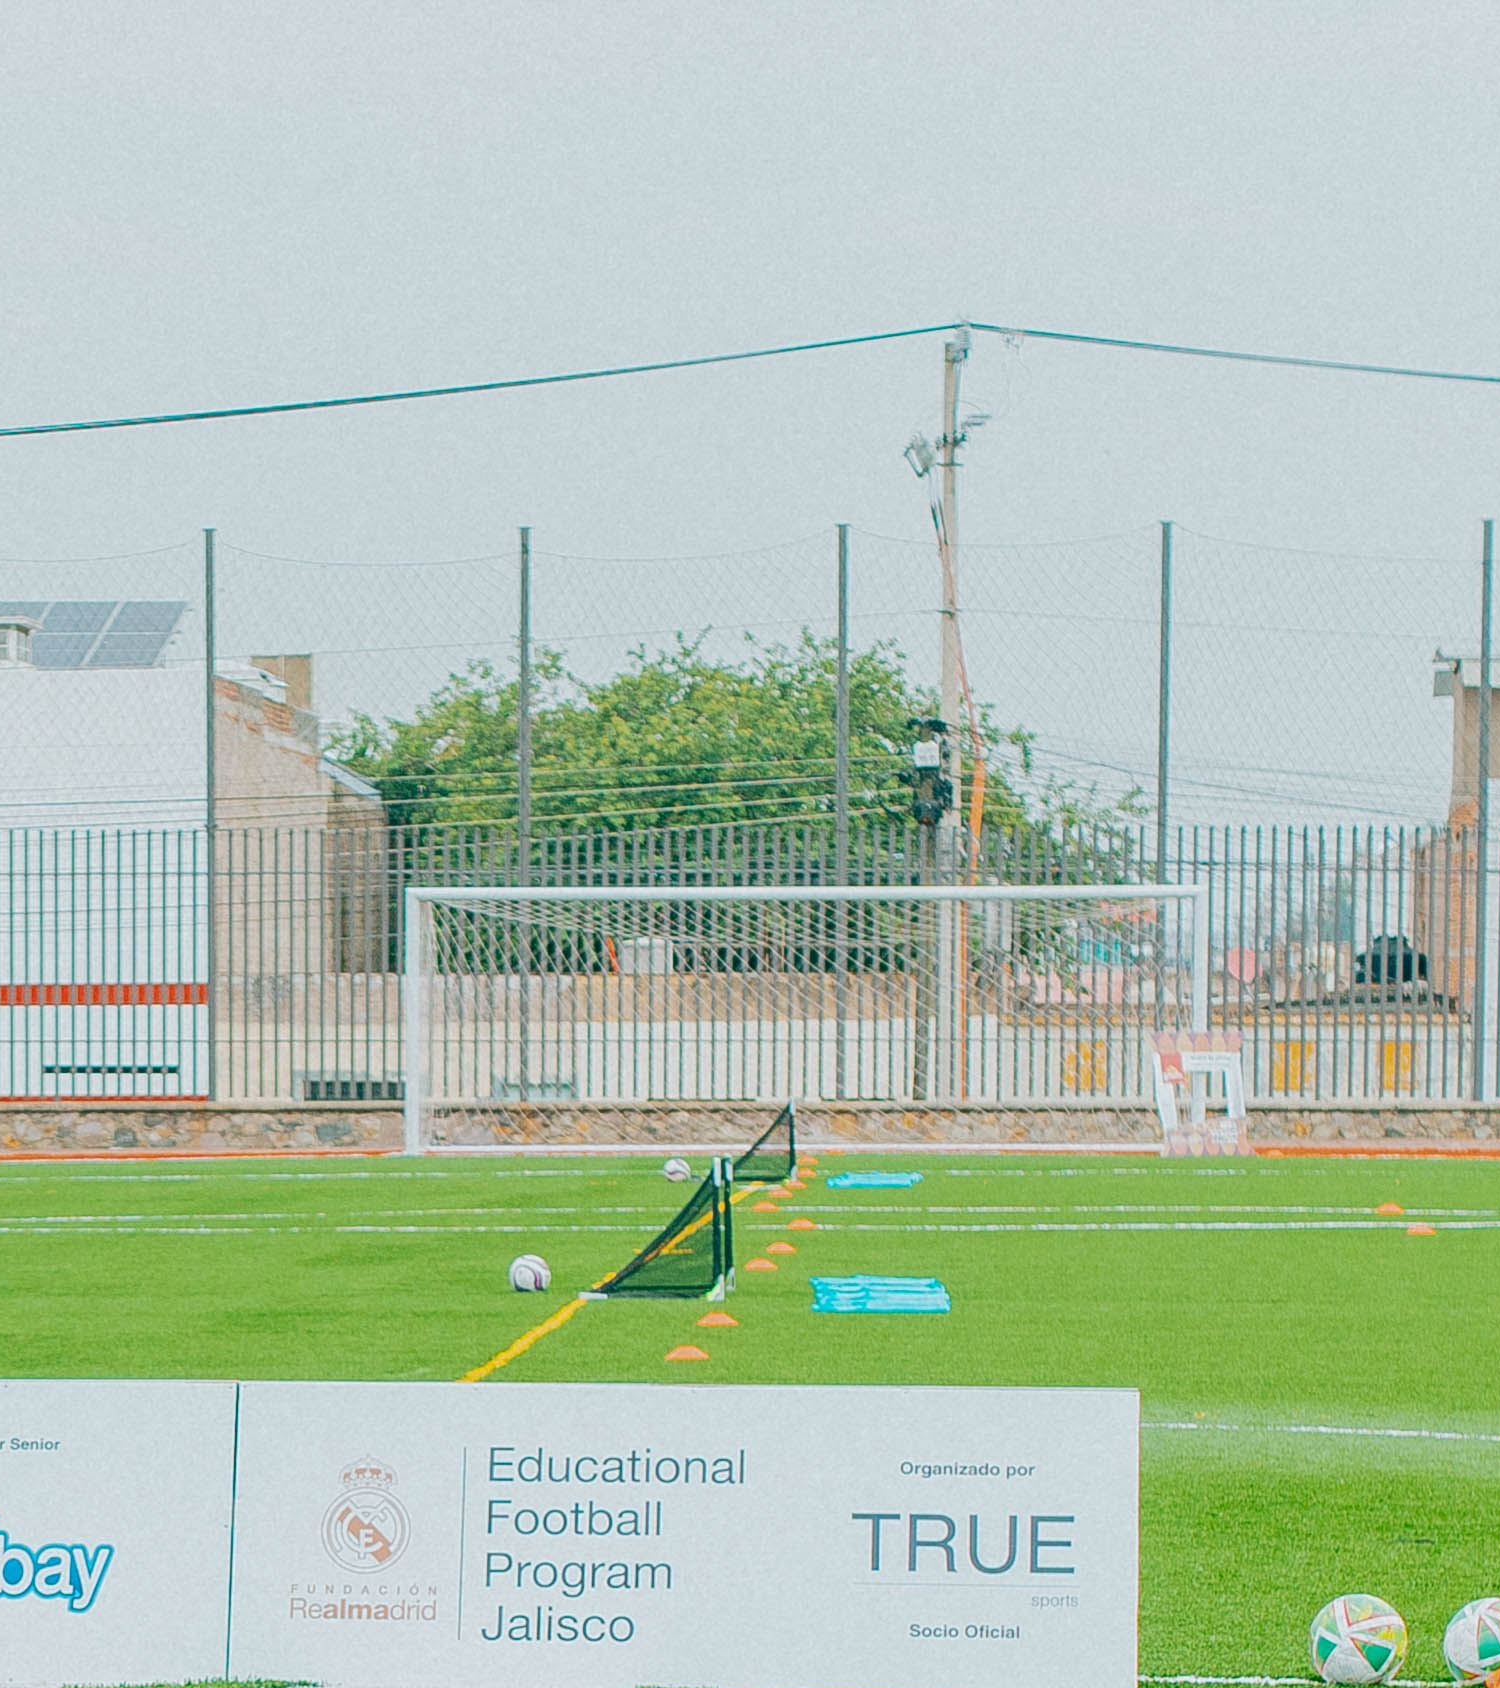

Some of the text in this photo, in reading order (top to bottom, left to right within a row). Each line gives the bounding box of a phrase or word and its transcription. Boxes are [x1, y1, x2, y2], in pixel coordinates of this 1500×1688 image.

[9, 1437, 62, 1451] Senior
[488, 1446, 745, 1485] Educational
[899, 1461, 1036, 1480] Organizado por
[486, 1499, 662, 1536] Football
[851, 1512, 1076, 1574] TRUE
[485, 1551, 673, 1598] Program
[289, 1583, 438, 1596] FUNDACIÓN
[289, 1597, 437, 1621] Realmadrid
[1030, 1594, 1079, 1610] sports
[480, 1604, 636, 1643] Jalisco
[909, 1623, 1020, 1640] Socio Oficial
